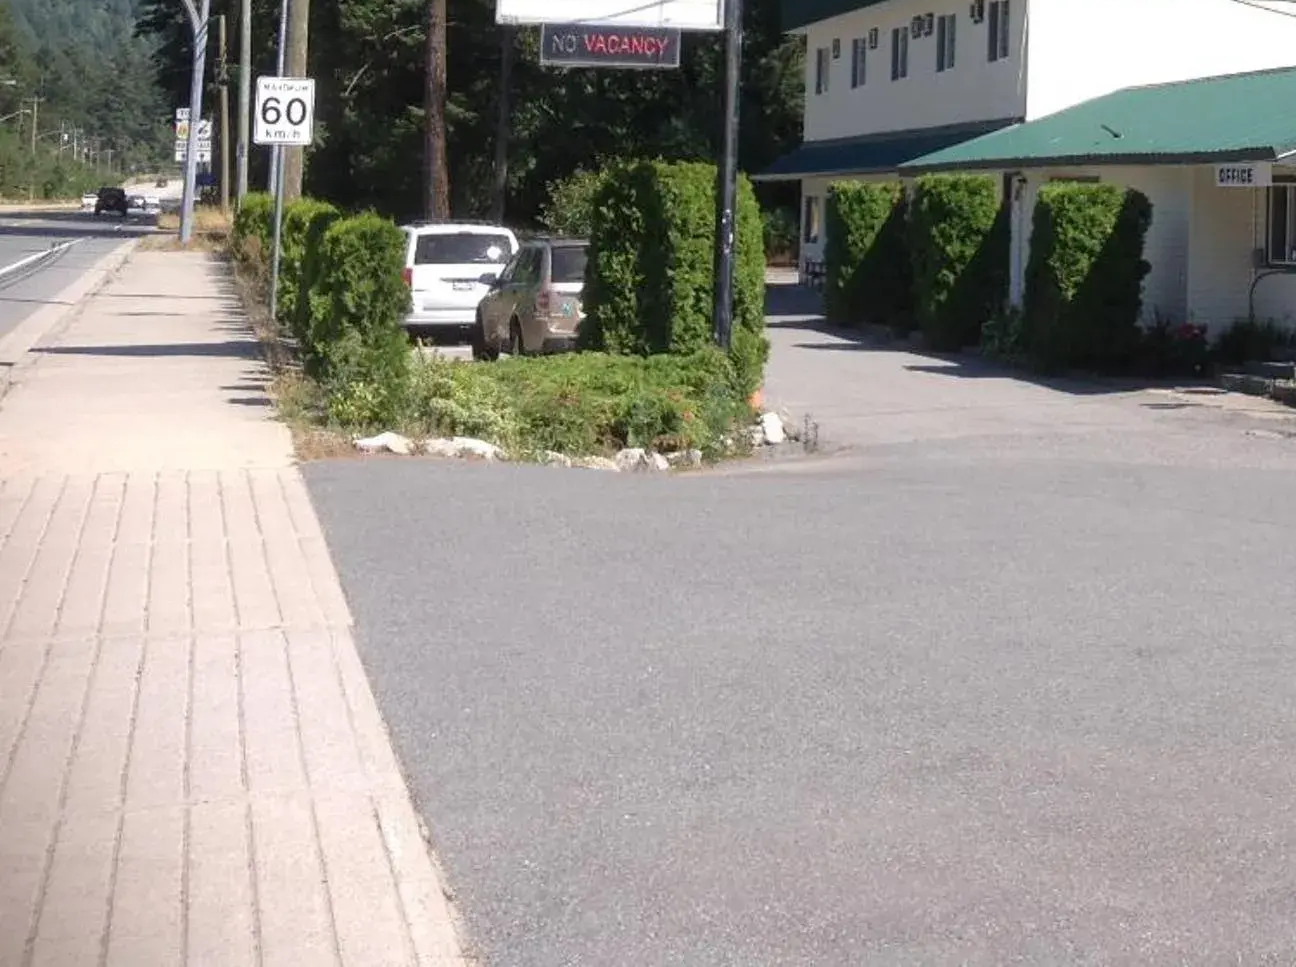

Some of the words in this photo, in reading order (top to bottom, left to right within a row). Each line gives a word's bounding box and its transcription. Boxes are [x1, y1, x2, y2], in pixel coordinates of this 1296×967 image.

[552, 34, 576, 54] NO
[584, 34, 670, 57] VACANCY
[262, 96, 307, 126] 60
[1218, 167, 1253, 184] OFFICE
